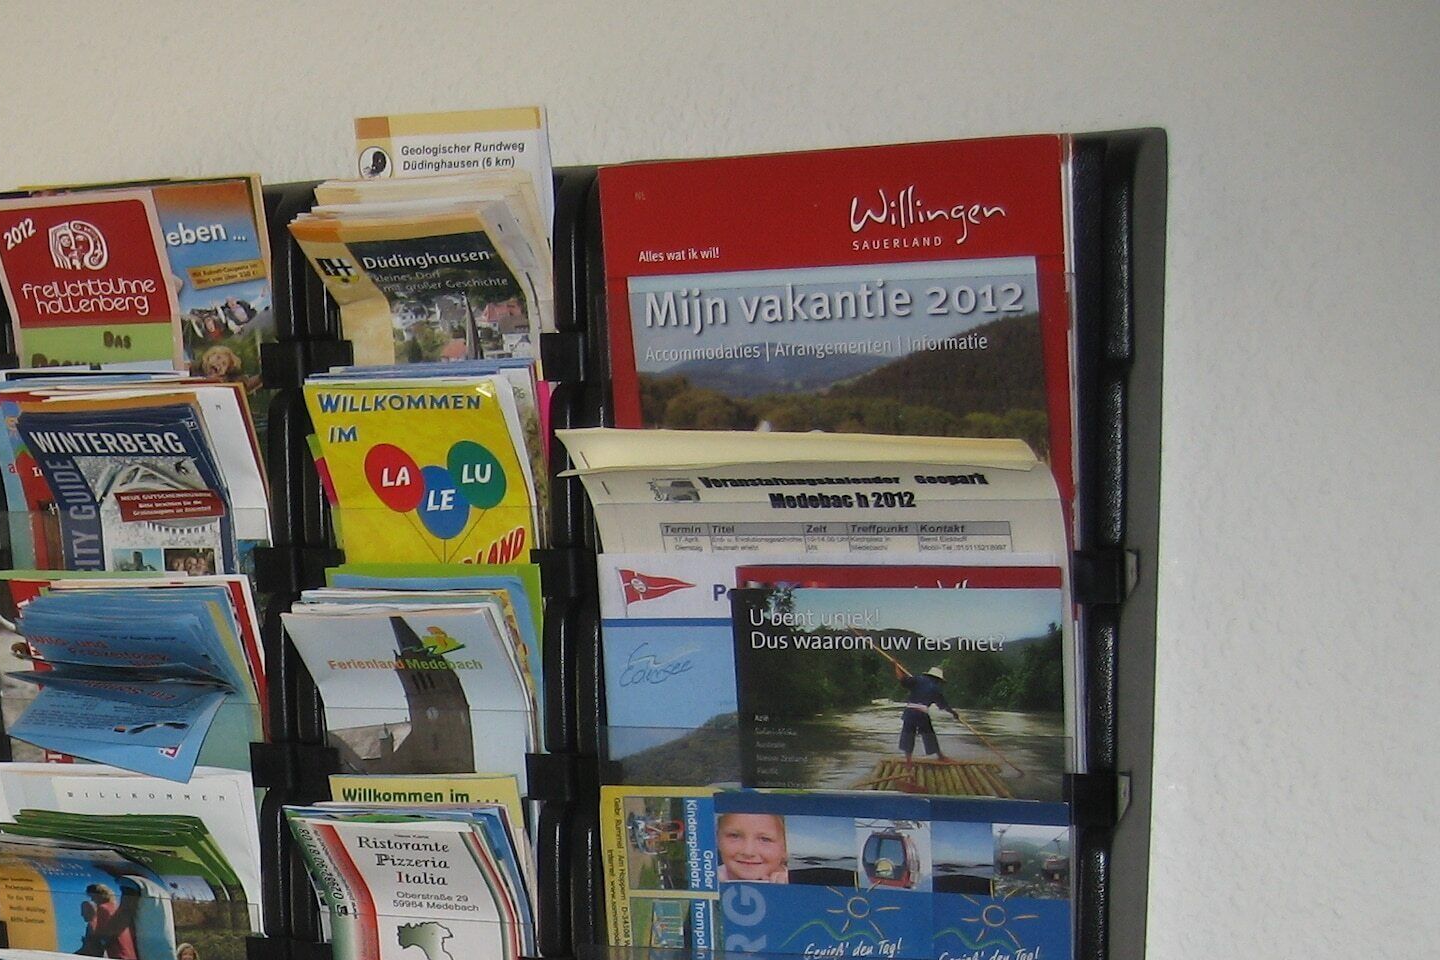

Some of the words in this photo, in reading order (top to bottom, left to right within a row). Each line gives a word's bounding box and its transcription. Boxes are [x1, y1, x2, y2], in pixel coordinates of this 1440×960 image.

[401, 144, 471, 157] Geologischer
[474, 141, 525, 155] Rundweg
[403, 158, 480, 171] Düdinghausen
[482, 157, 492, 170] (6
[495, 156, 515, 169] km)
[849, 184, 1006, 245] Willingen
[3, 218, 37, 250] 2012
[852, 236, 943, 251] SAUERLAND
[362, 250, 490, 272] Düdinghausen
[638, 249, 664, 262] Alles
[666, 250, 686, 261] wat
[688, 248, 698, 260] ik
[700, 247, 720, 260] wil!
[415, 270, 441, 281] Dorf
[405, 281, 442, 293] großer
[446, 277, 508, 290] Geschichte
[35, 293, 149, 316] hallenberg
[645, 288, 728, 335] Mijn
[738, 280, 912, 325] vakantie
[925, 282, 1024, 316] 2012
[645, 341, 761, 362] Accommodaties
[775, 336, 892, 360] Arrangementen
[907, 332, 988, 352] Informatie
[317, 393, 481, 413] WILLKOMMEN
[29, 431, 186, 454] WINTERBERG
[329, 426, 357, 443] IM
[382, 466, 410, 487] LA
[462, 463, 492, 484] LU
[914, 472, 989, 488] Geopark
[49, 458, 101, 519] GUIDE
[426, 489, 456, 511] LE
[872, 490, 915, 508] 2012
[663, 524, 702, 535] Termin
[711, 525, 736, 535] Titel
[806, 524, 827, 534] Zeit
[850, 523, 909, 537] Treffpunkt
[920, 523, 964, 535] Kontakt
[750, 609, 763, 626] U
[771, 607, 817, 627] bent
[821, 607, 881, 628] uniek!
[751, 632, 789, 650] Dus
[793, 634, 874, 651] waarom
[880, 636, 912, 651] uw
[918, 634, 952, 651] reis
[958, 634, 1006, 653] niet?
[328, 659, 405, 671] Ferienland
[406, 657, 483, 671] Medebach
[342, 788, 444, 802] Willkommen
[449, 788, 470, 802] im
[357, 836, 449, 852] Ristorante
[686, 799, 699, 889] Kinderspielplatz
[376, 853, 450, 869] Pizzeria
[702, 850, 714, 889] Großer
[396, 870, 448, 885] Italia
[852, 942, 874, 957] den
[877, 938, 903, 957] Tag!
